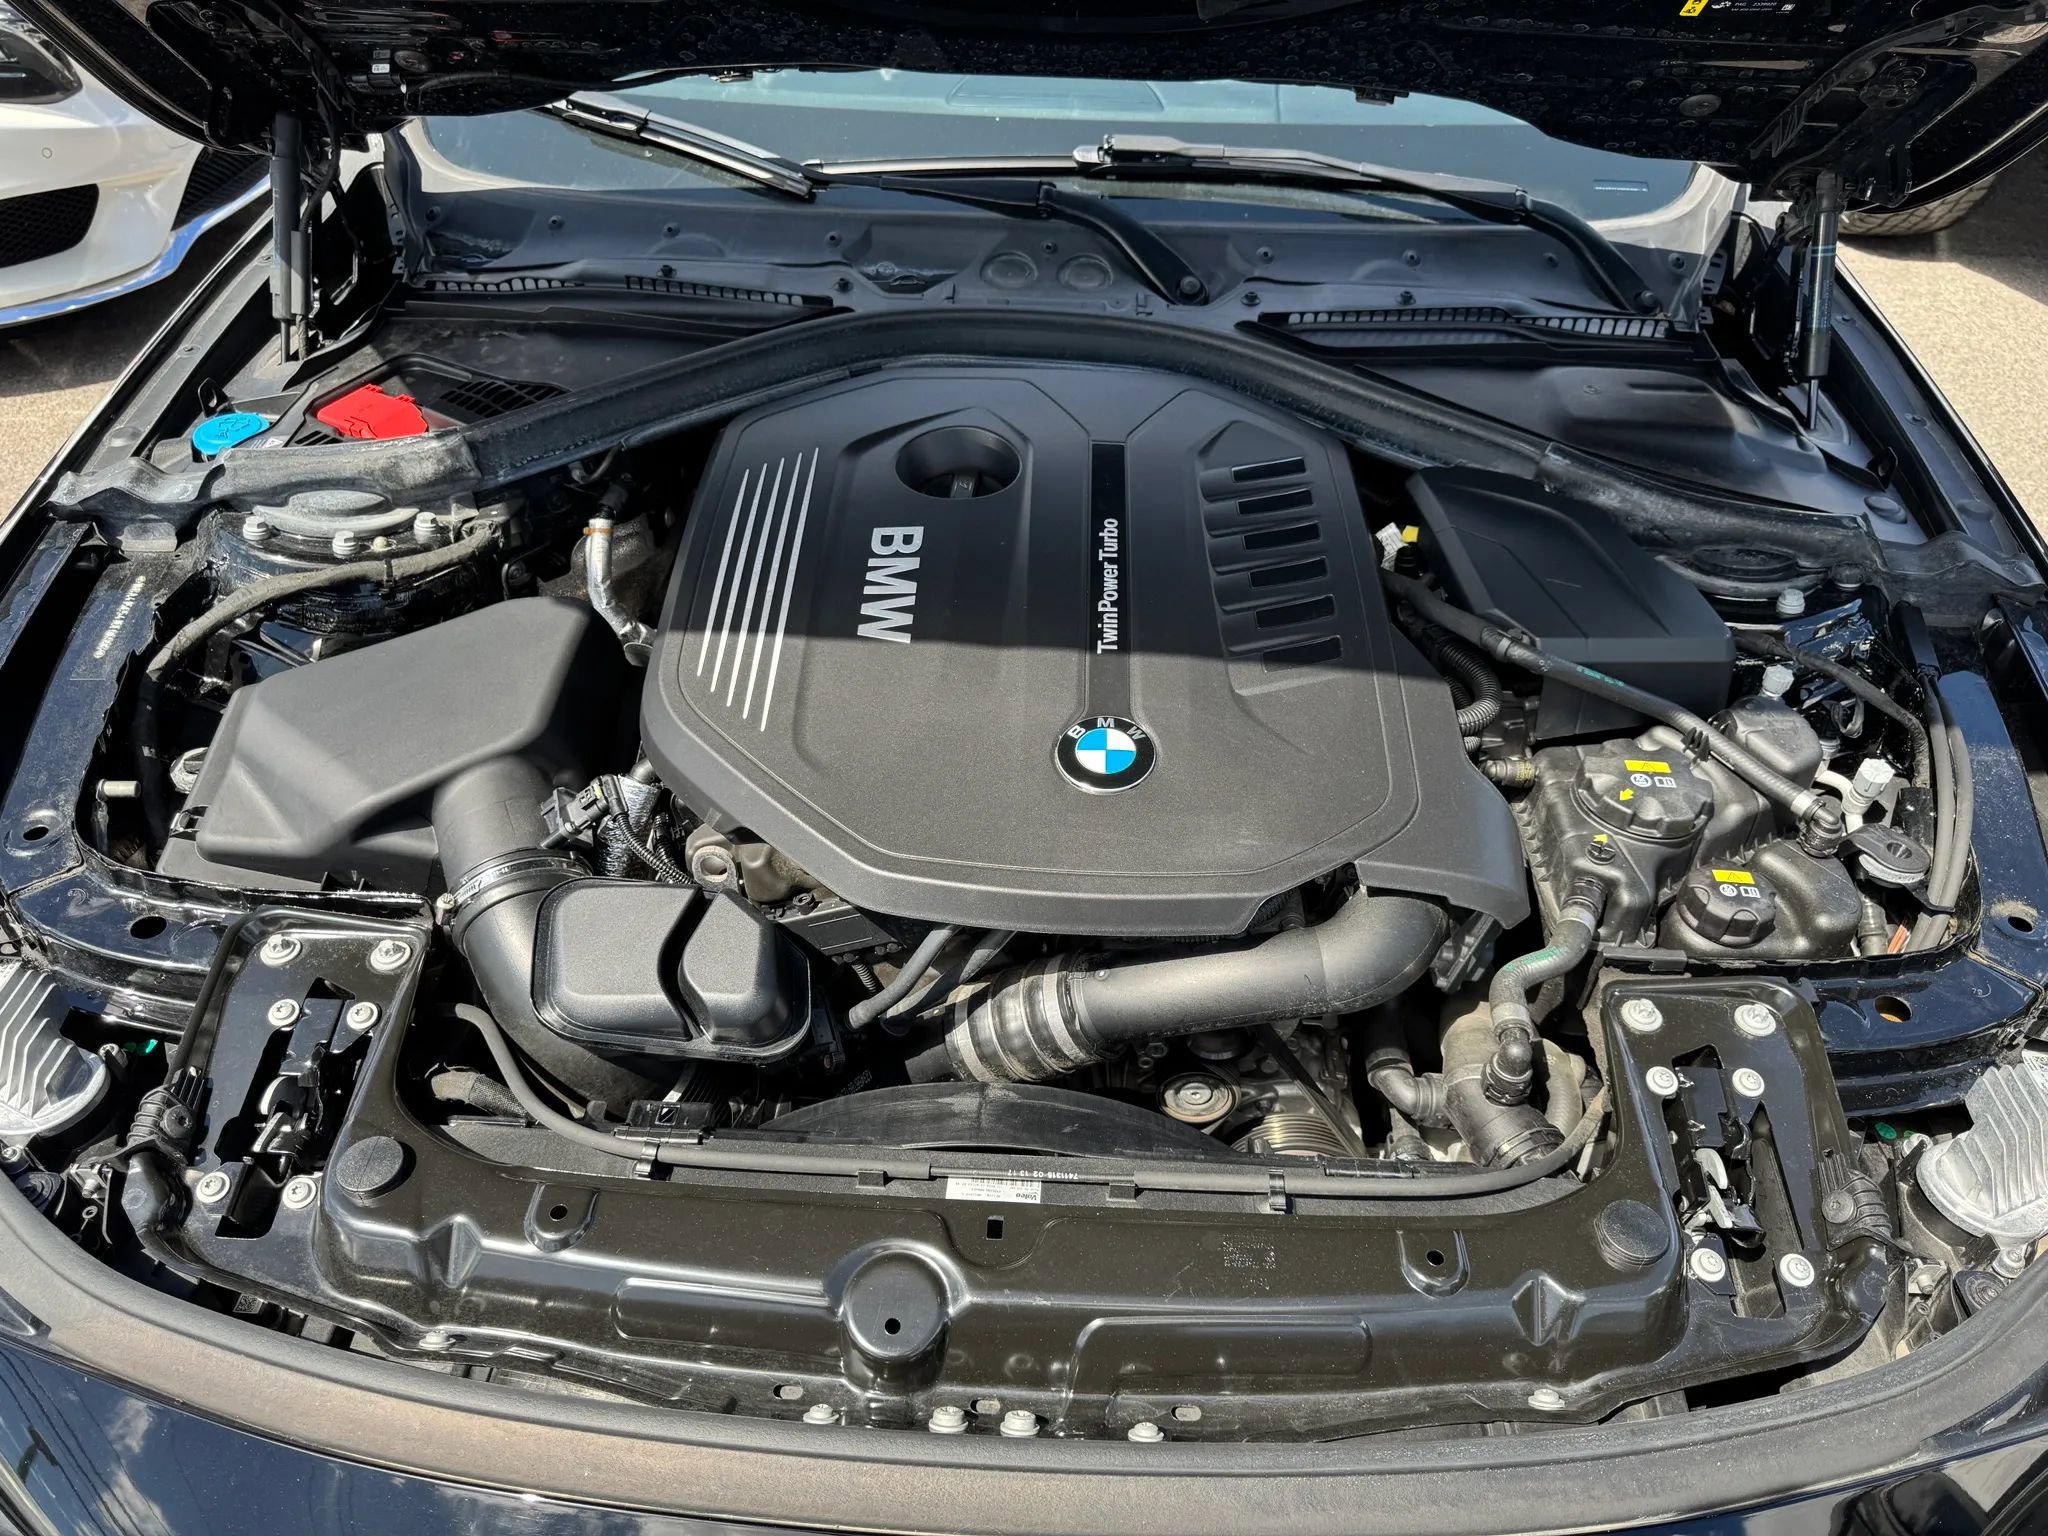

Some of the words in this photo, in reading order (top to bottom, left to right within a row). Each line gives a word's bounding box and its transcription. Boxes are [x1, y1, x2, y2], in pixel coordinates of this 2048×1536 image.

[1098, 518, 1119, 561] Turbo
[857, 526, 925, 644] BMW
[1067, 717, 1147, 741] BMW
[1015, 1192, 1038, 1201] Valeo
